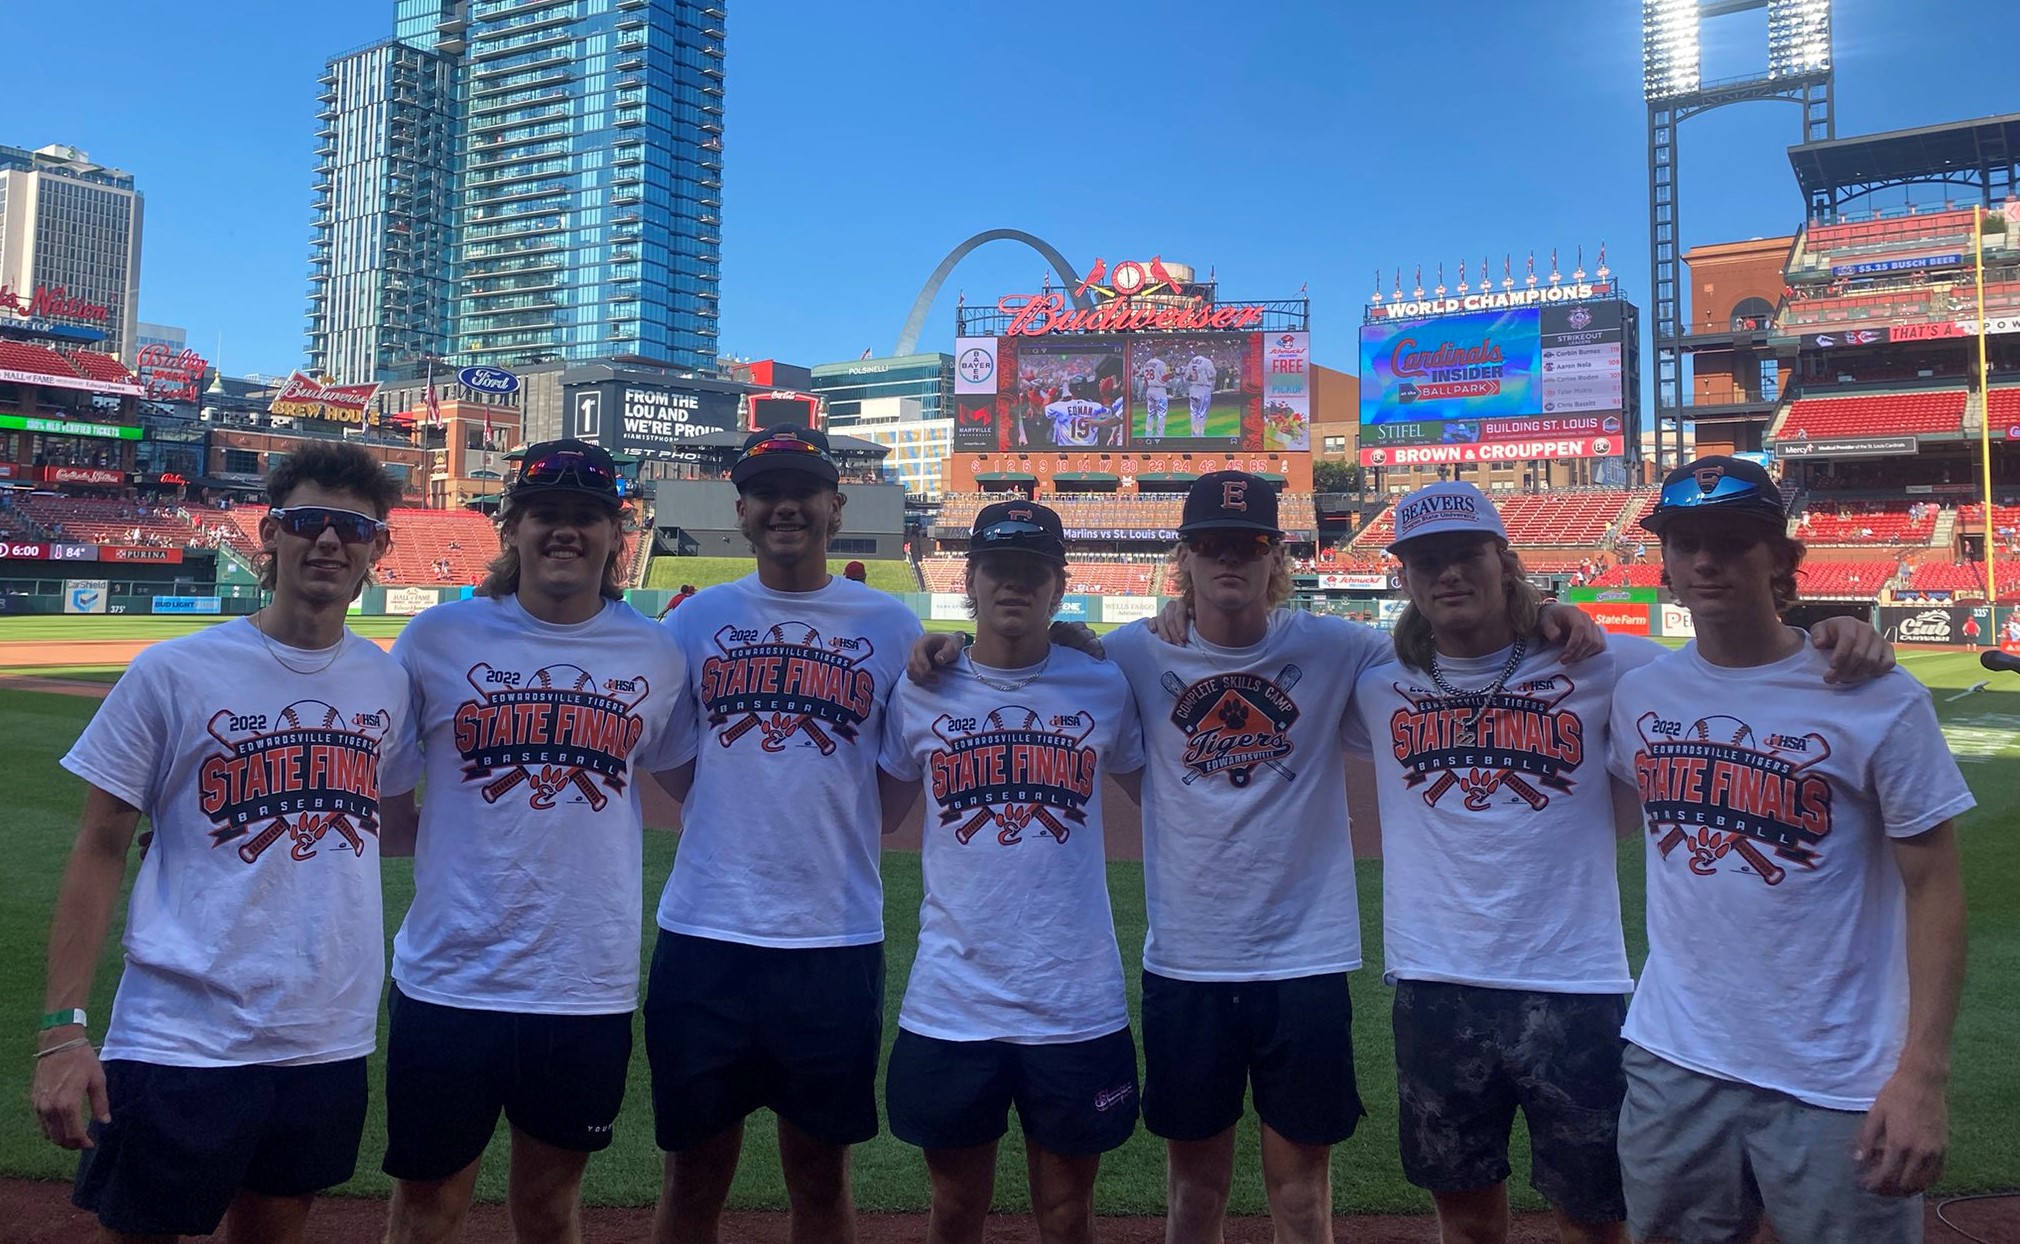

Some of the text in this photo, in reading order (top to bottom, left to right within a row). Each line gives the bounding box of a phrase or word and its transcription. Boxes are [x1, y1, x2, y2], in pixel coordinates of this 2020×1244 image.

[1891, 260, 1926, 270] BUSCH
[1930, 256, 1956, 266] BEER
[1386, 284, 1593, 318] WORLD CHAMPIONS
[998, 292, 1265, 337] Budweiser
[1558, 332, 1603, 342] STRIKEOUT
[1892, 325, 1938, 340] THAT'S
[1944, 325, 1951, 336] A
[1272, 359, 1303, 374] FREE
[1391, 338, 1503, 378] Cardinals
[4, 371, 26, 380] HALL
[33, 374, 55, 384] FAME
[848, 365, 889, 375] POLSINELLI
[1432, 365, 1504, 382] INSIDER
[471, 370, 511, 390] Ford
[1272, 383, 1303, 395] PICKUP
[1422, 382, 1488, 397] BALLPARK
[624, 388, 699, 409] FROM THE
[271, 401, 380, 426] BREW HOUE
[624, 403, 689, 422] LOU AND
[624, 418, 672, 436] WE'RE
[1070, 417, 1092, 439] 19
[1378, 423, 1425, 440] STIFEL
[1486, 420, 1540, 434] BUILDING
[1543, 419, 1560, 432] ST.
[1563, 418, 1598, 431] LOUIS
[1395, 440, 1585, 464] BROWN & CROUPPEN
[1785, 446, 1808, 454] Mercy
[995, 460, 1268, 473] 1 2 6 9 10 14 17 20 23 24 42 45 85
[1220, 480, 1248, 512] E
[1402, 496, 1476, 524] BEAVERS
[1063, 529, 1098, 538] Marlins
[1114, 529, 1127, 538] St.
[1130, 529, 1156, 538] Louis
[12, 545, 39, 557] 6:00
[126, 549, 167, 560] PURINA
[66, 580, 106, 589] CarShield
[1339, 576, 1382, 584] Schnucks
[729, 630, 758, 642] 2022
[1900, 618, 1950, 636] Club
[732, 647, 849, 668] EDWARDSVILLE TIGERS
[486, 670, 521, 685] 2022
[702, 657, 874, 718] STATE FINALS
[492, 692, 624, 714] EDWARDSVILLE TIGERS
[1176, 676, 1294, 720] COMPLETE SKILLS CAMP
[1504, 698, 1546, 712] TIGERS
[720, 700, 842, 723] BASEBALL
[229, 714, 267, 732] 2022
[455, 703, 642, 761] STATE FINALS
[948, 718, 976, 732] 2022
[1652, 720, 1682, 736] 2022
[239, 733, 373, 754] EDWARDSVILLE TIGERS
[954, 734, 1073, 751] EDWARDSVILLE TIGERS
[1185, 725, 1291, 763] Tigers
[1393, 708, 1580, 765] STATE FINALS
[483, 752, 614, 775] BASEBALL
[1206, 751, 1274, 772] EDWARDSVILLE
[1419, 756, 1550, 774] BASEBALL
[1653, 745, 1790, 774] EDWARDSVILLE TIGERS
[202, 746, 304, 814] STATE
[932, 744, 1097, 800] STATE FINALS
[954, 791, 1077, 810] BASEBALL
[1635, 754, 1830, 836] STATE FINALS
[238, 798, 368, 823] BASEBALL
[1653, 810, 1788, 844] BASEBALL
